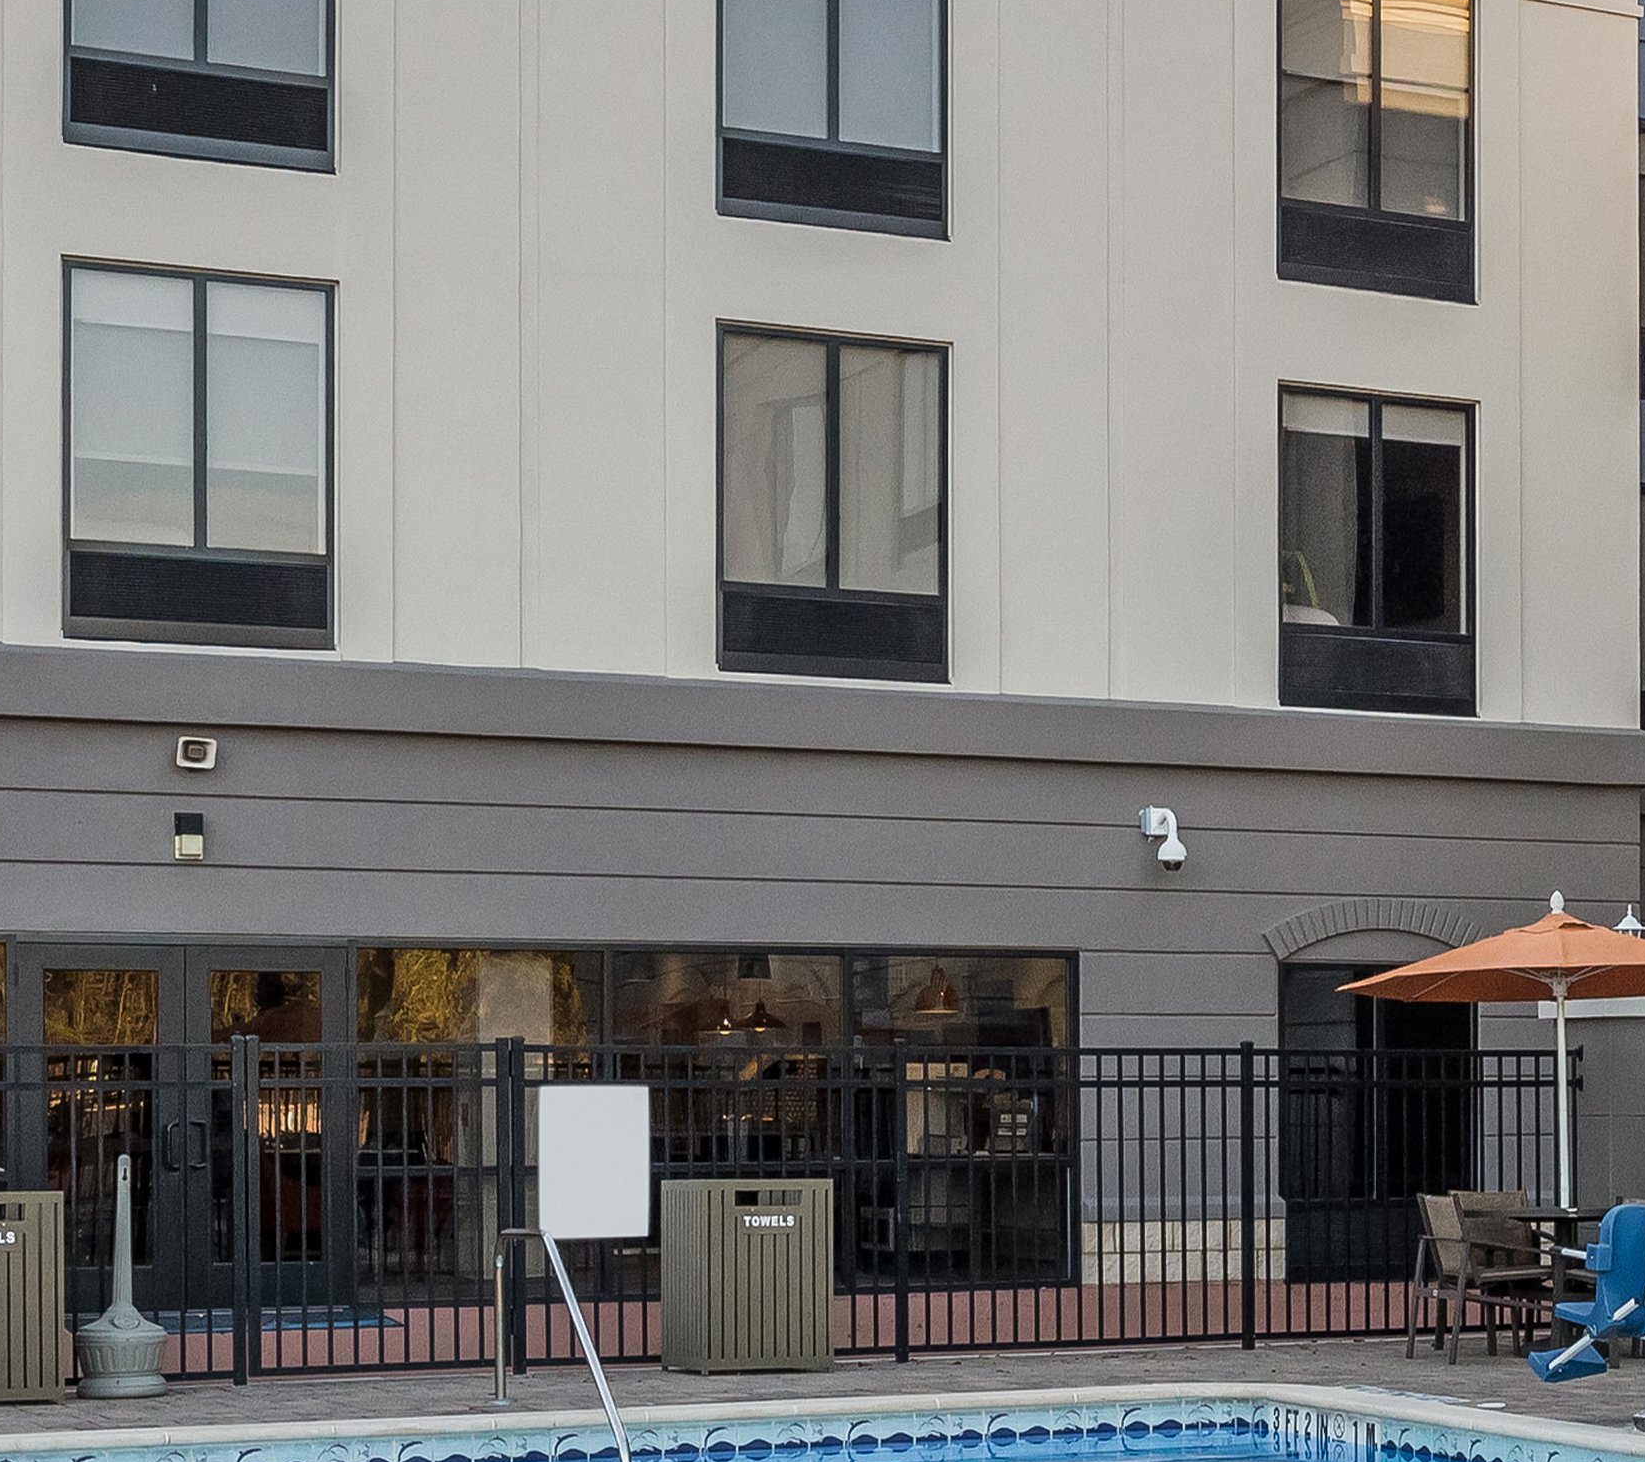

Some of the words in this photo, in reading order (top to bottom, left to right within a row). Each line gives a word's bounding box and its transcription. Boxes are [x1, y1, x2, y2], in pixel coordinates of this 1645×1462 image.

[743, 1215, 795, 1227] TOWELS
[1273, 1406, 1281, 1431] 3
[1305, 1411, 1312, 1437] 2
